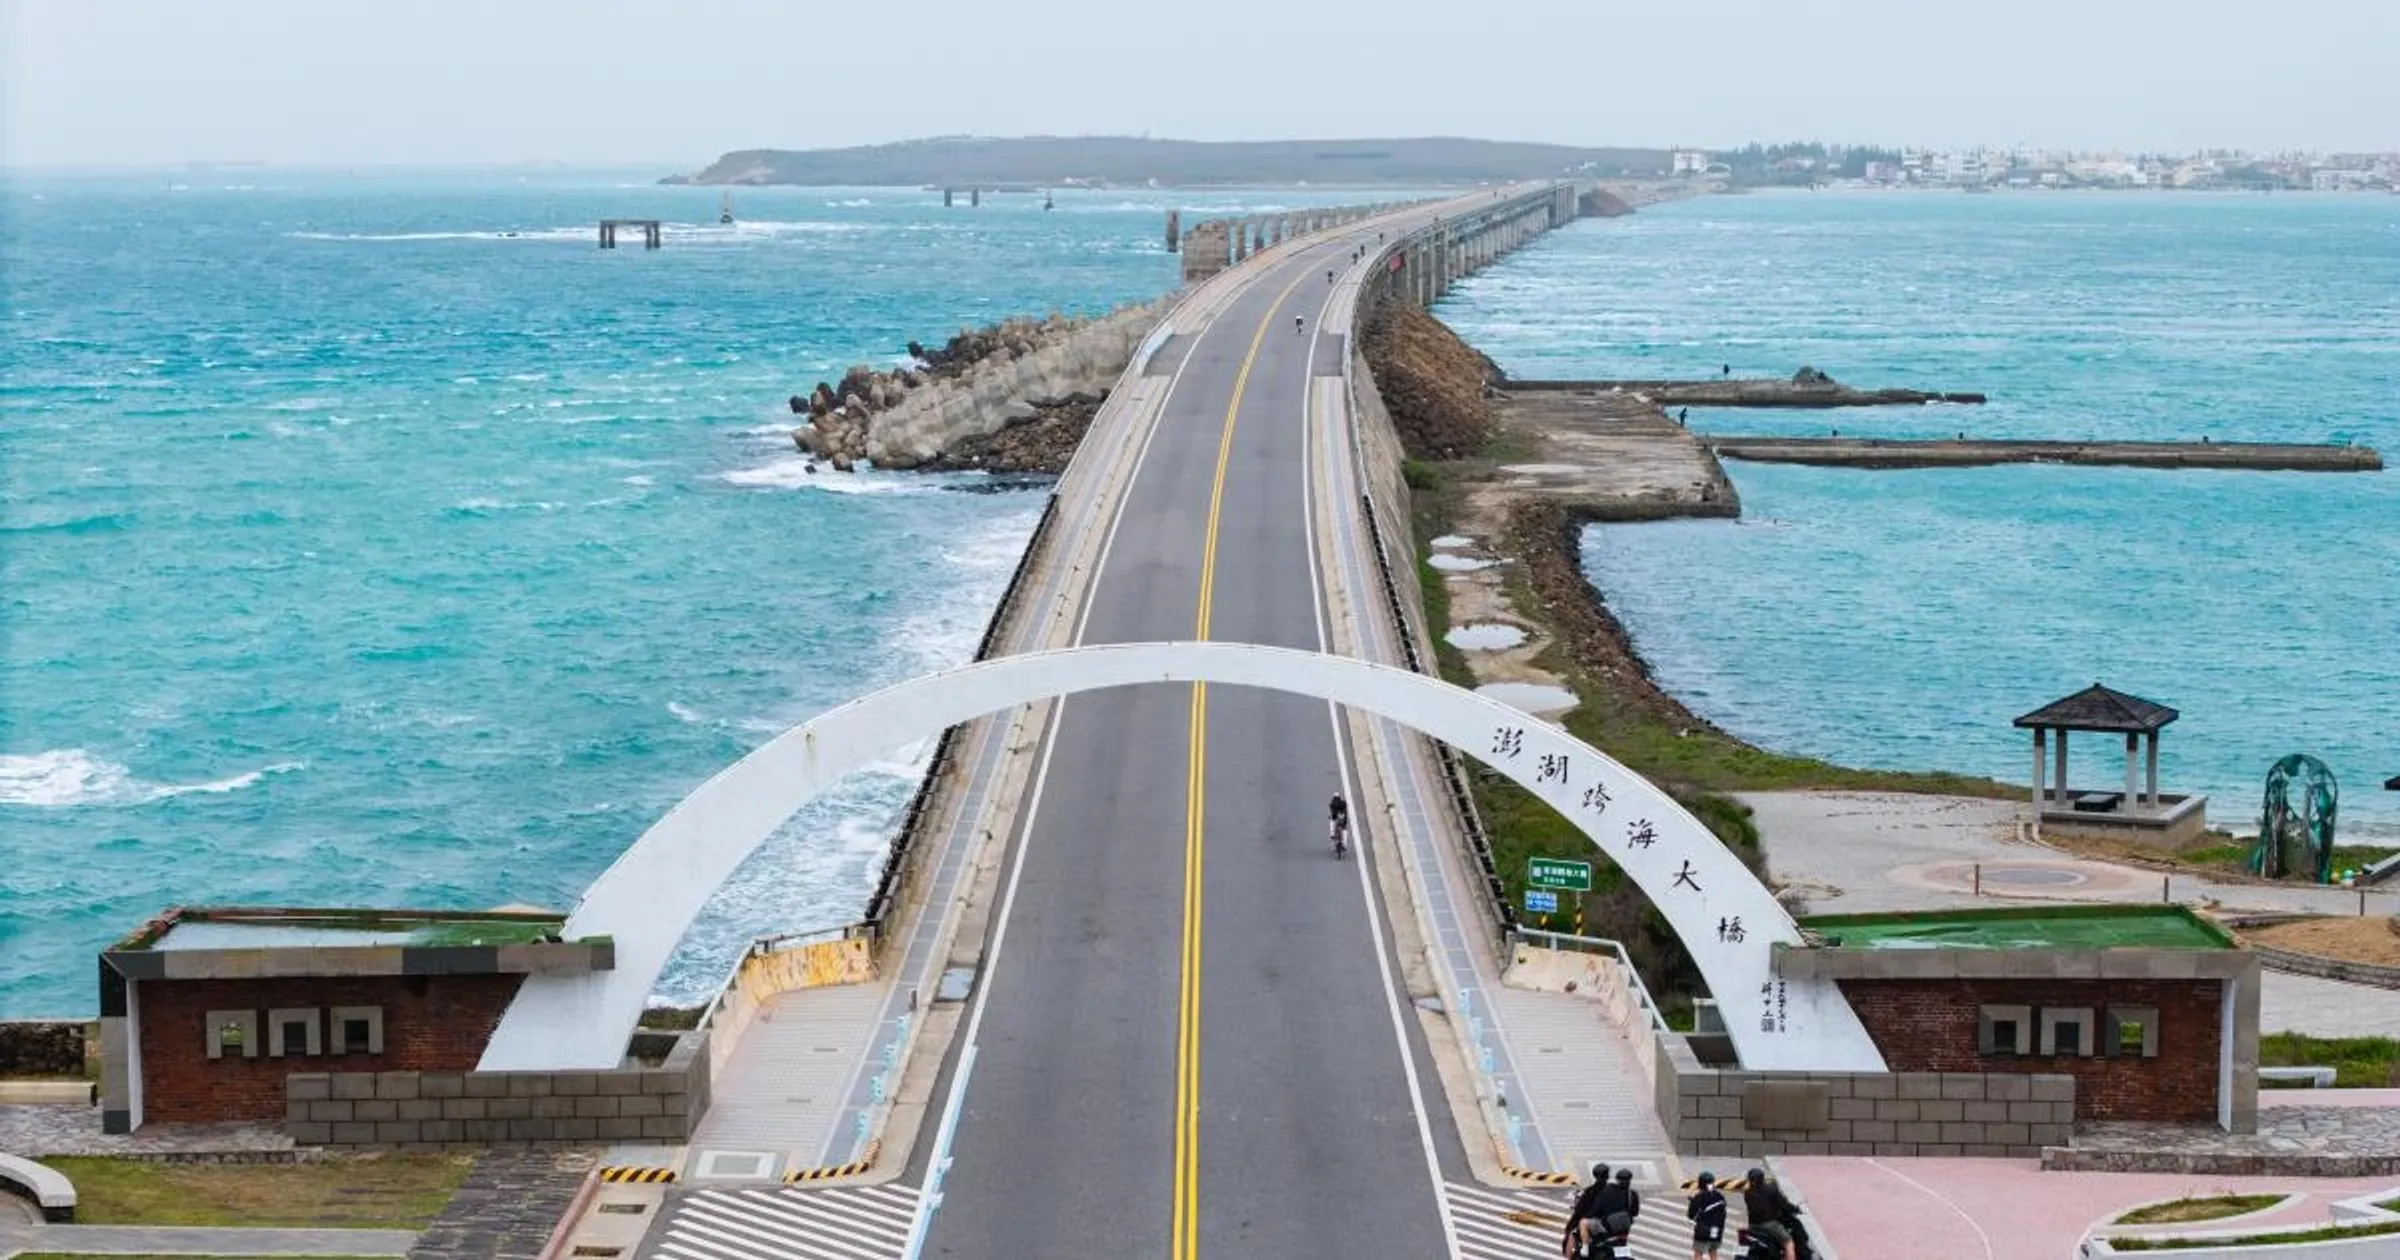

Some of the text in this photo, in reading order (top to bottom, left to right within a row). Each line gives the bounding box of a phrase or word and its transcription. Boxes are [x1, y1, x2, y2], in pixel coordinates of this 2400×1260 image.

[1492, 727, 1747, 943] 澎湖跨海大橋
